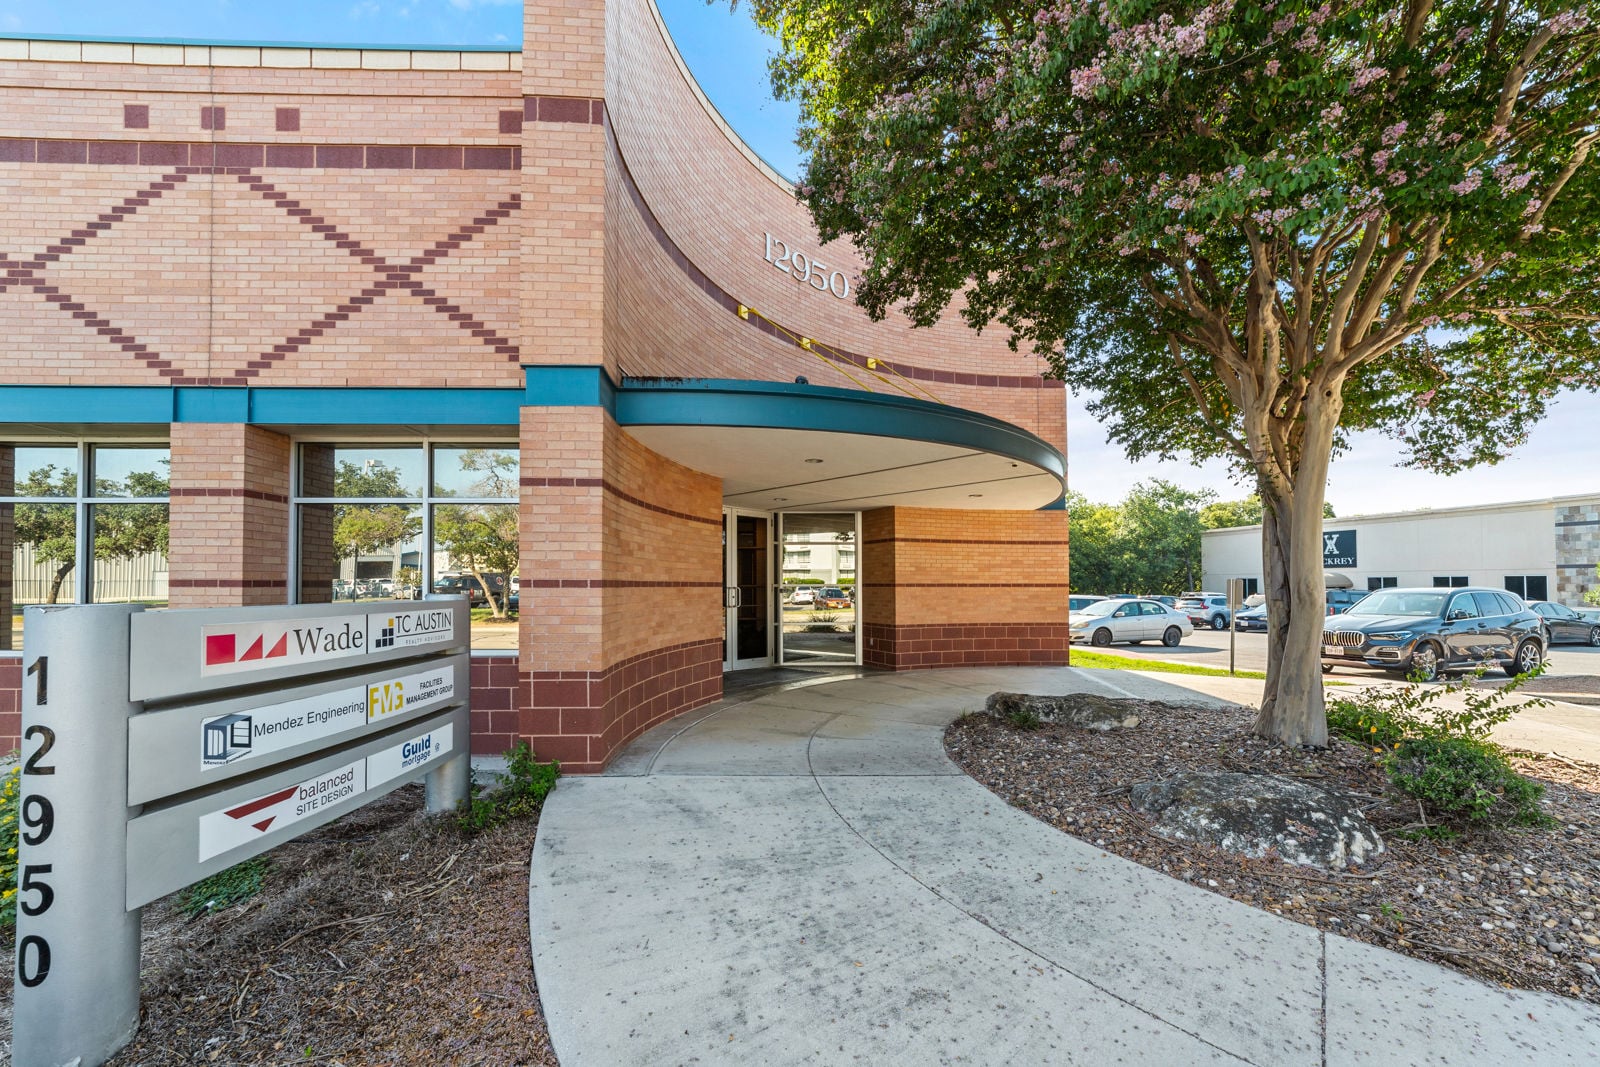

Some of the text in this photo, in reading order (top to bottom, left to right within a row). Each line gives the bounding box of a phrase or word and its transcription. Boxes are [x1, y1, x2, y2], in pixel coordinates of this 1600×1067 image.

[763, 232, 850, 299] 12950
[395, 611, 452, 634] TC AUSTIN
[293, 623, 363, 655] Wade
[369, 682, 404, 717] FMG
[406, 684, 453, 704] MANAGEMENT GROUP
[419, 677, 443, 690] FACILITIES
[254, 701, 365, 737] Mendez Engineering
[402, 734, 431, 758] Guild
[402, 750, 431, 768] mortgage
[296, 783, 354, 816] SITE DESIGN
[300, 768, 354, 801] balanced
[18, 656, 55, 988] 12950
